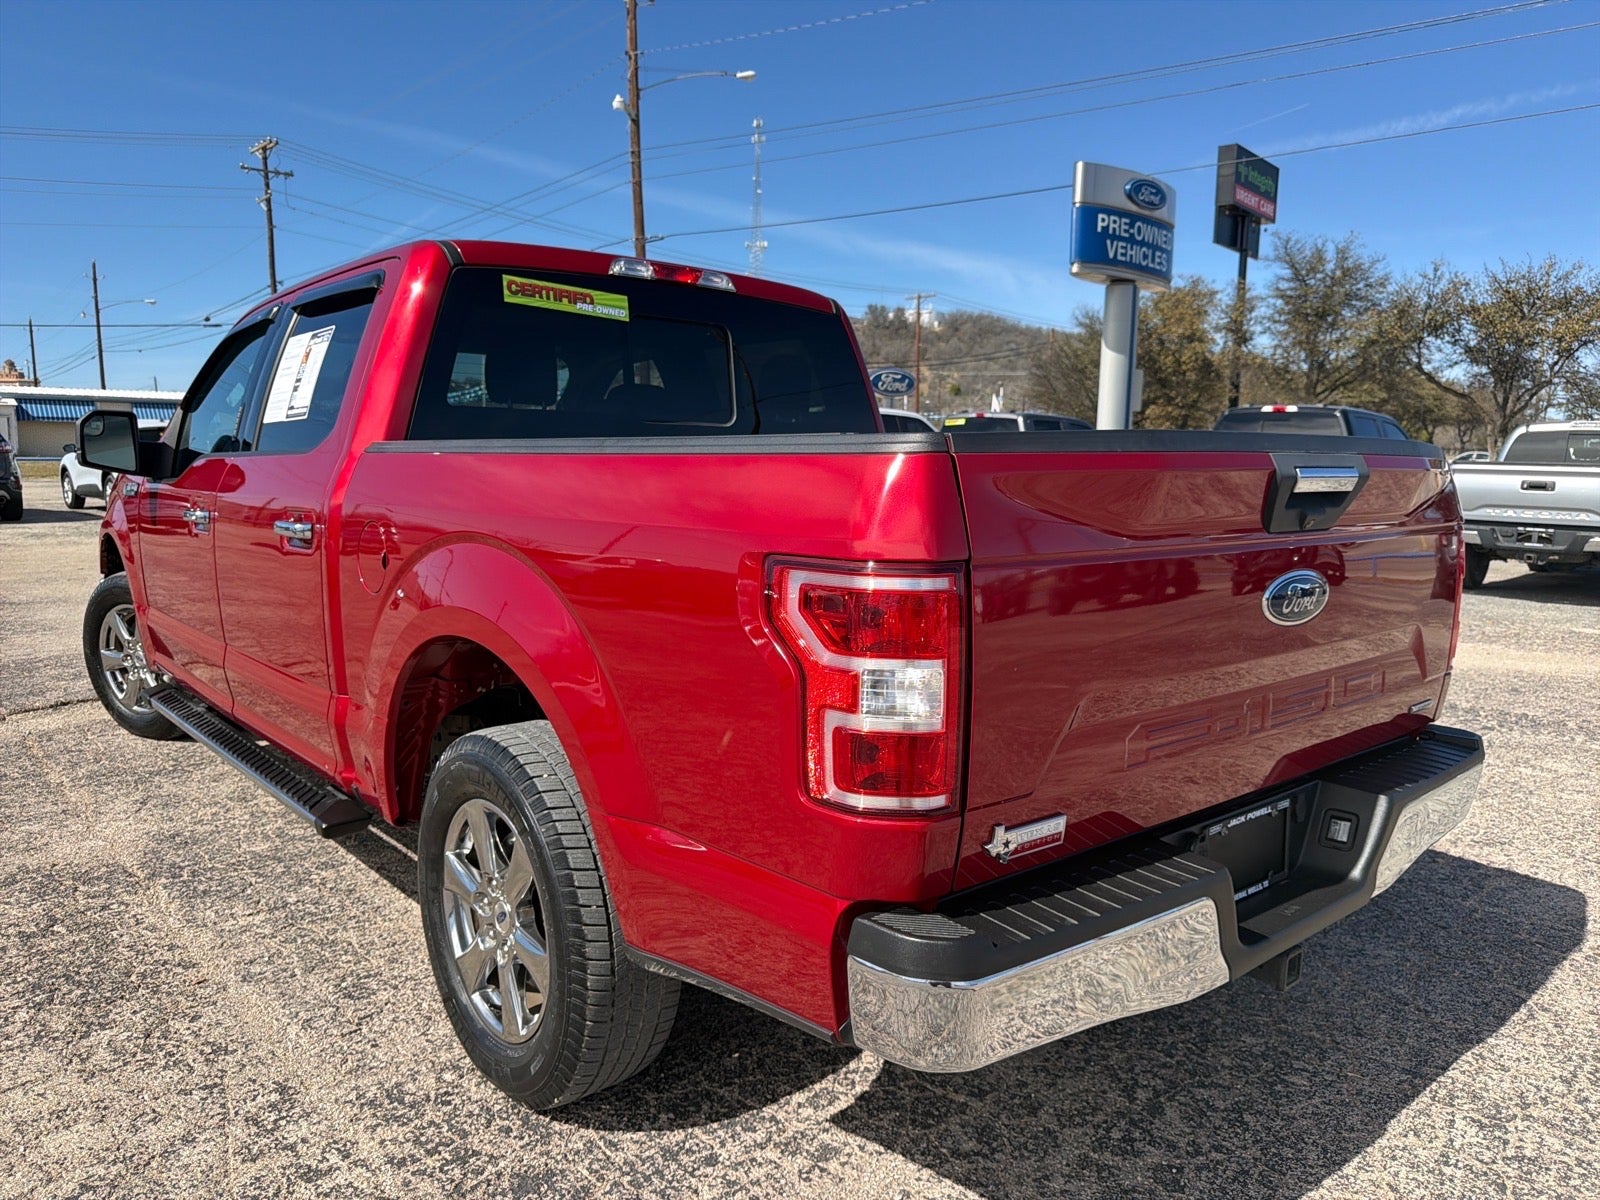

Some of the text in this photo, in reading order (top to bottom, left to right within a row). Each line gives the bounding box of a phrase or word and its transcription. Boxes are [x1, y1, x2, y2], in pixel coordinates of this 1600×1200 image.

[1138, 184, 1161, 204] Ford
[1235, 187, 1275, 218] URGENT CARE
[1097, 213, 1172, 251] PRE-OWNED
[1106, 239, 1168, 272] VEHICLES
[506, 279, 595, 305] CERTIFIED
[576, 303, 626, 317] PRE-OWNED
[877, 373, 909, 391] Ford
[1486, 508, 1591, 521] TACOMA
[1282, 583, 1320, 615] Ford
[1228, 806, 1273, 828] JACK POWELL
[1018, 822, 1063, 842] TEXAS
[1018, 834, 1061, 850] EDITION
